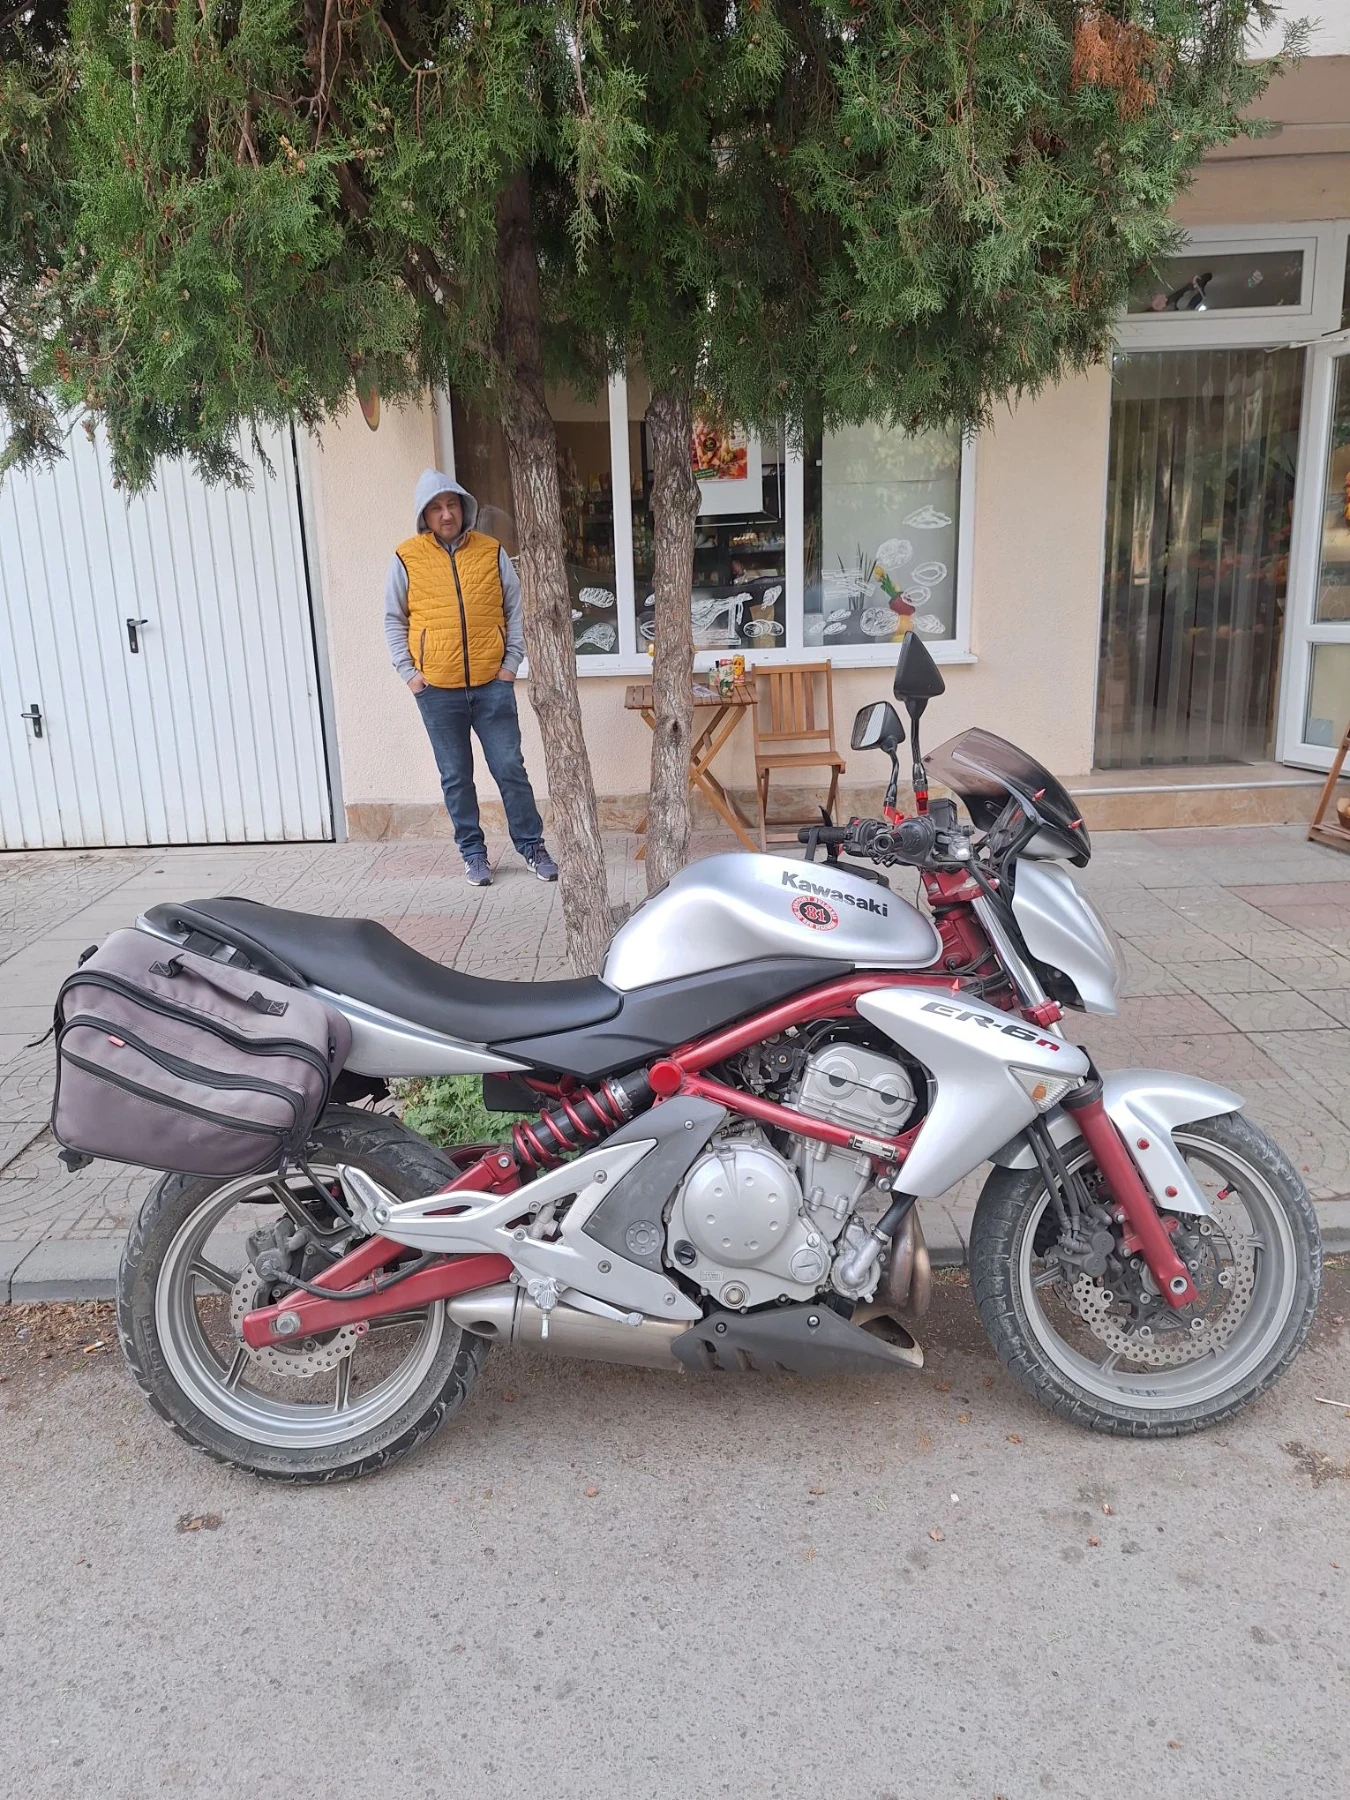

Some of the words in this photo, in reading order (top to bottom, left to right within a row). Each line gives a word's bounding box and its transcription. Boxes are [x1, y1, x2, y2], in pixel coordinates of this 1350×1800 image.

[781, 871, 888, 917] Kawasaki
[804, 904, 827, 923] 81
[920, 1001, 1060, 1051] ER-6n
